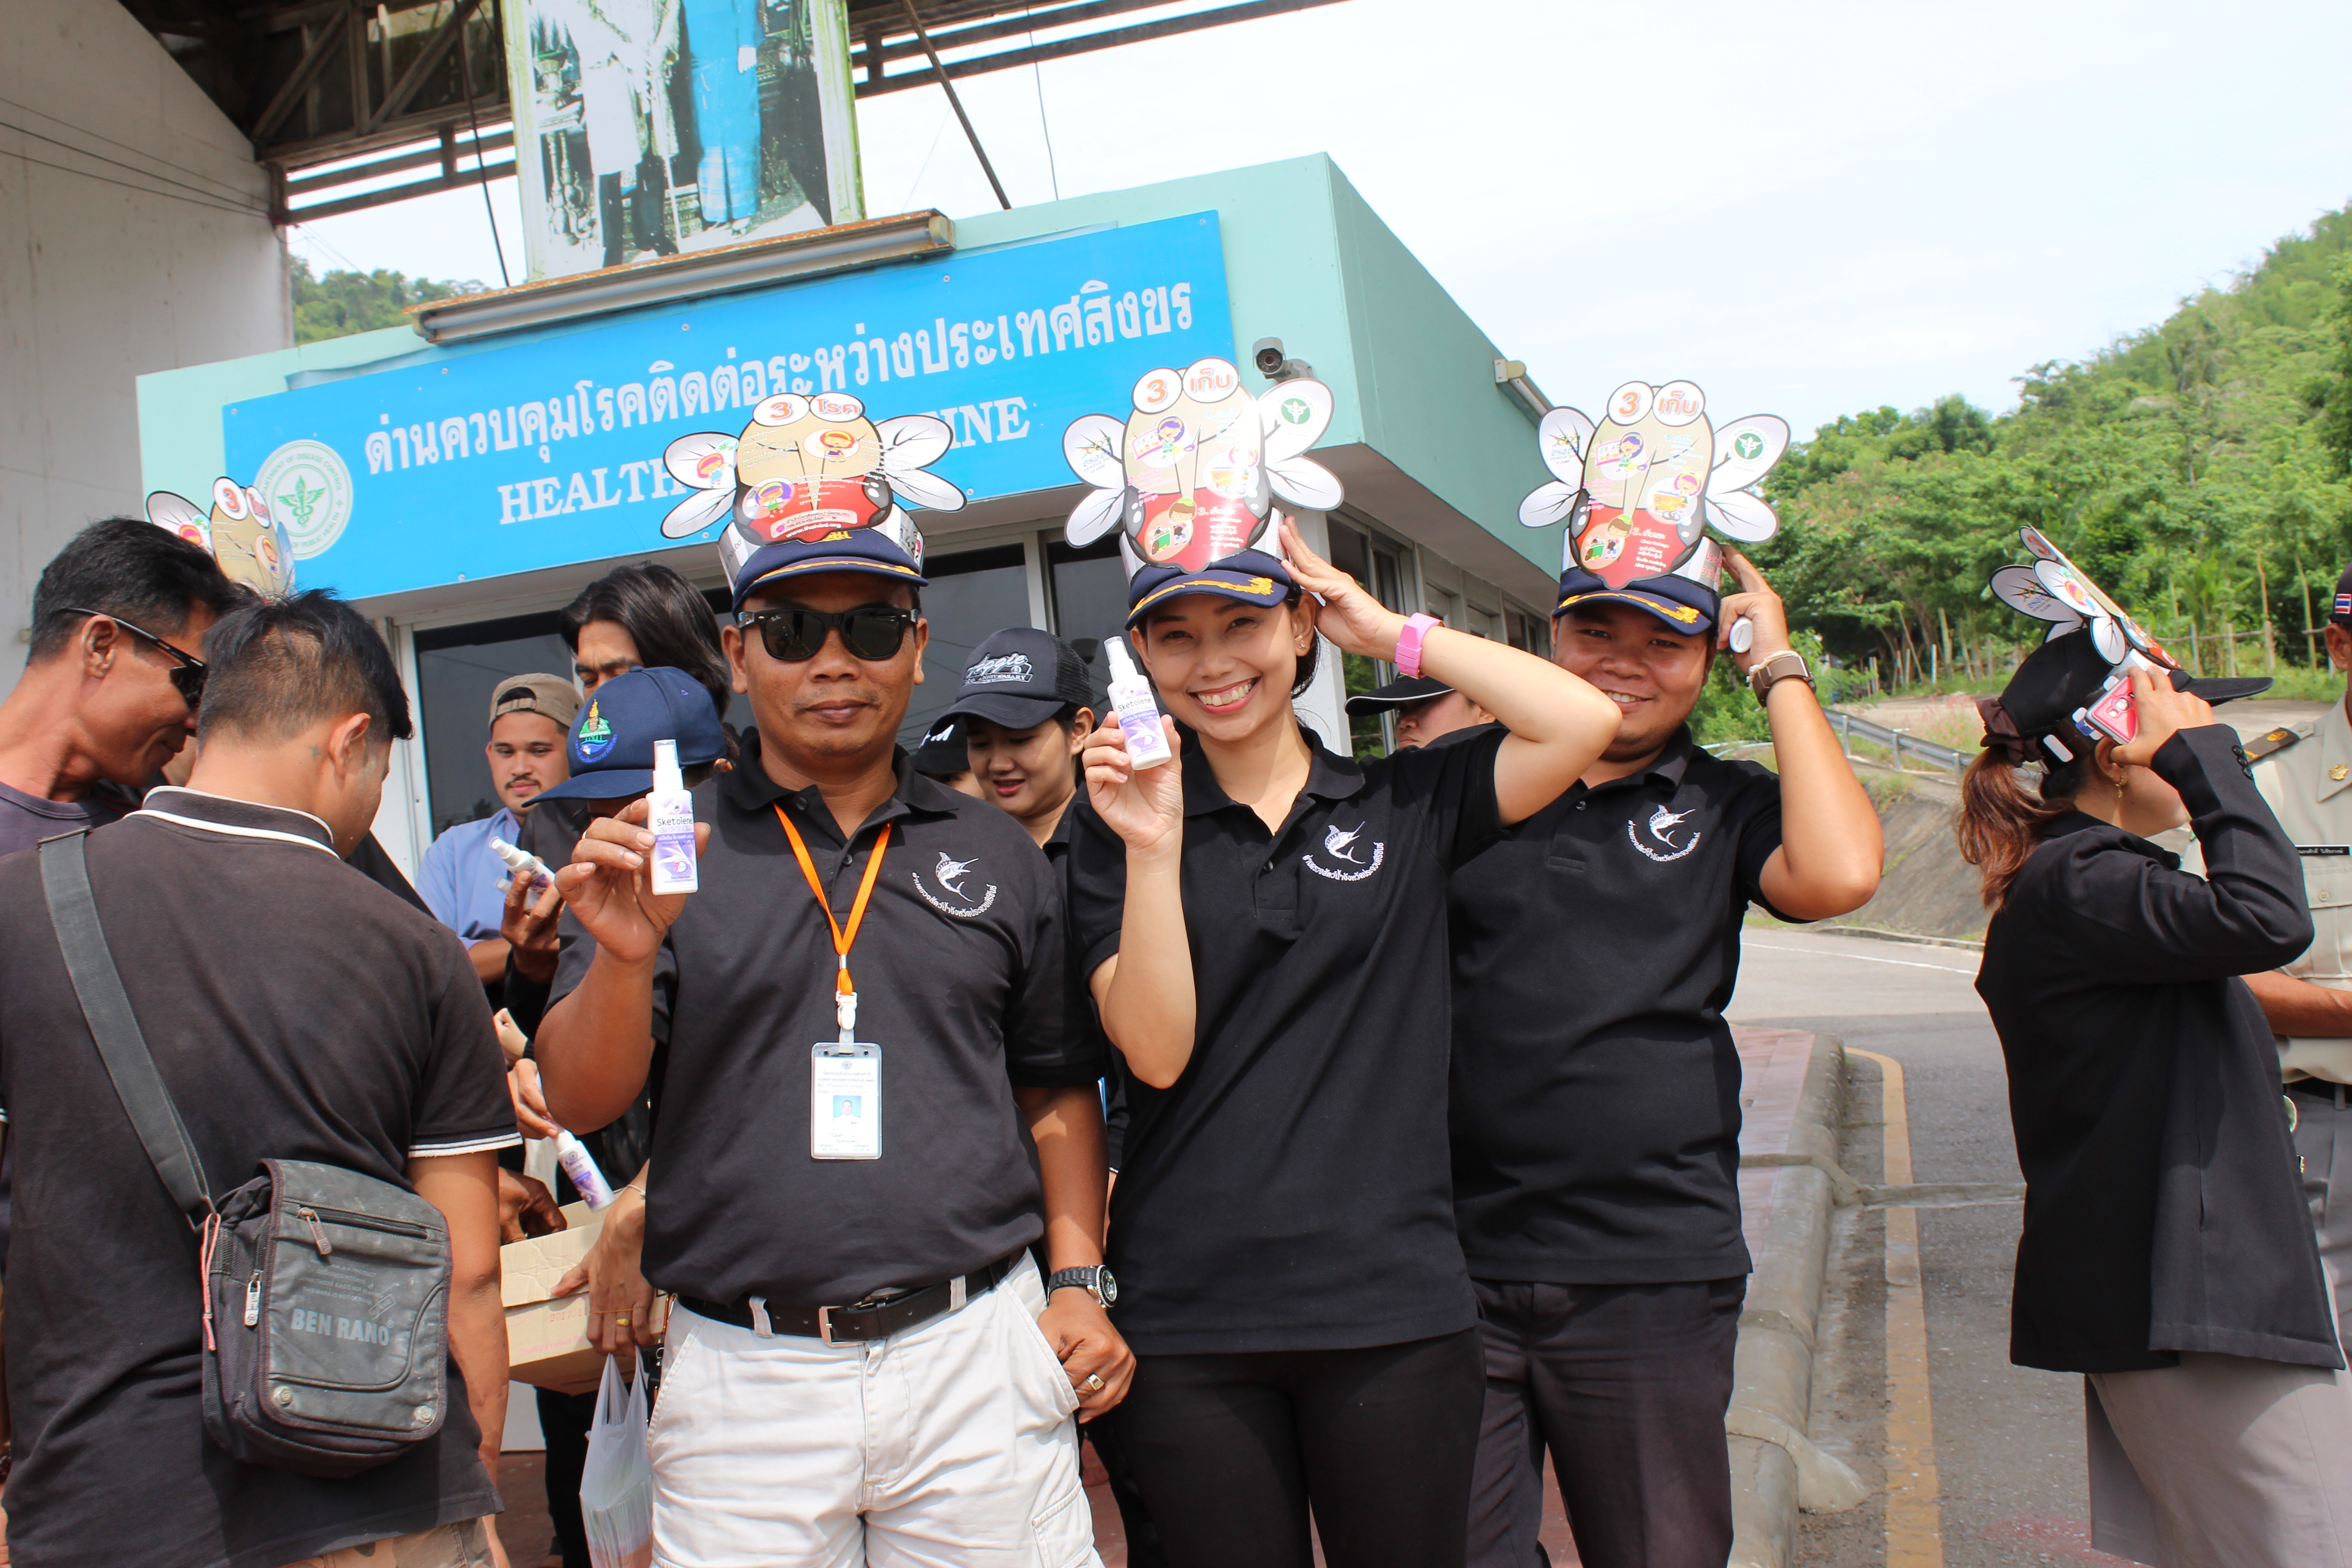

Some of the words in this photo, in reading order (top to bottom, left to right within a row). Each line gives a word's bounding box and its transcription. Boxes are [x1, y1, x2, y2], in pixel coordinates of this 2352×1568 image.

[365, 278, 1194, 475] ด่านควบคุมโรคติดต่อระหว่างประเทศสิงขร
[1146, 378, 1166, 404] 3
[1190, 367, 1231, 392] เก็บ
[769, 401, 791, 420] 3
[816, 397, 859, 415] โรค
[1619, 391, 1640, 416] 3
[1657, 389, 1698, 415] เก็บ
[222, 487, 239, 511] 3
[497, 457, 687, 525] HEALTH
[785, 523, 842, 538] www.thaivbd.org
[1117, 697, 1152, 712] Sketolene
[657, 816, 693, 827] Sketolene
[290, 1307, 333, 1336] BEN
[336, 1317, 391, 1347] RANO
